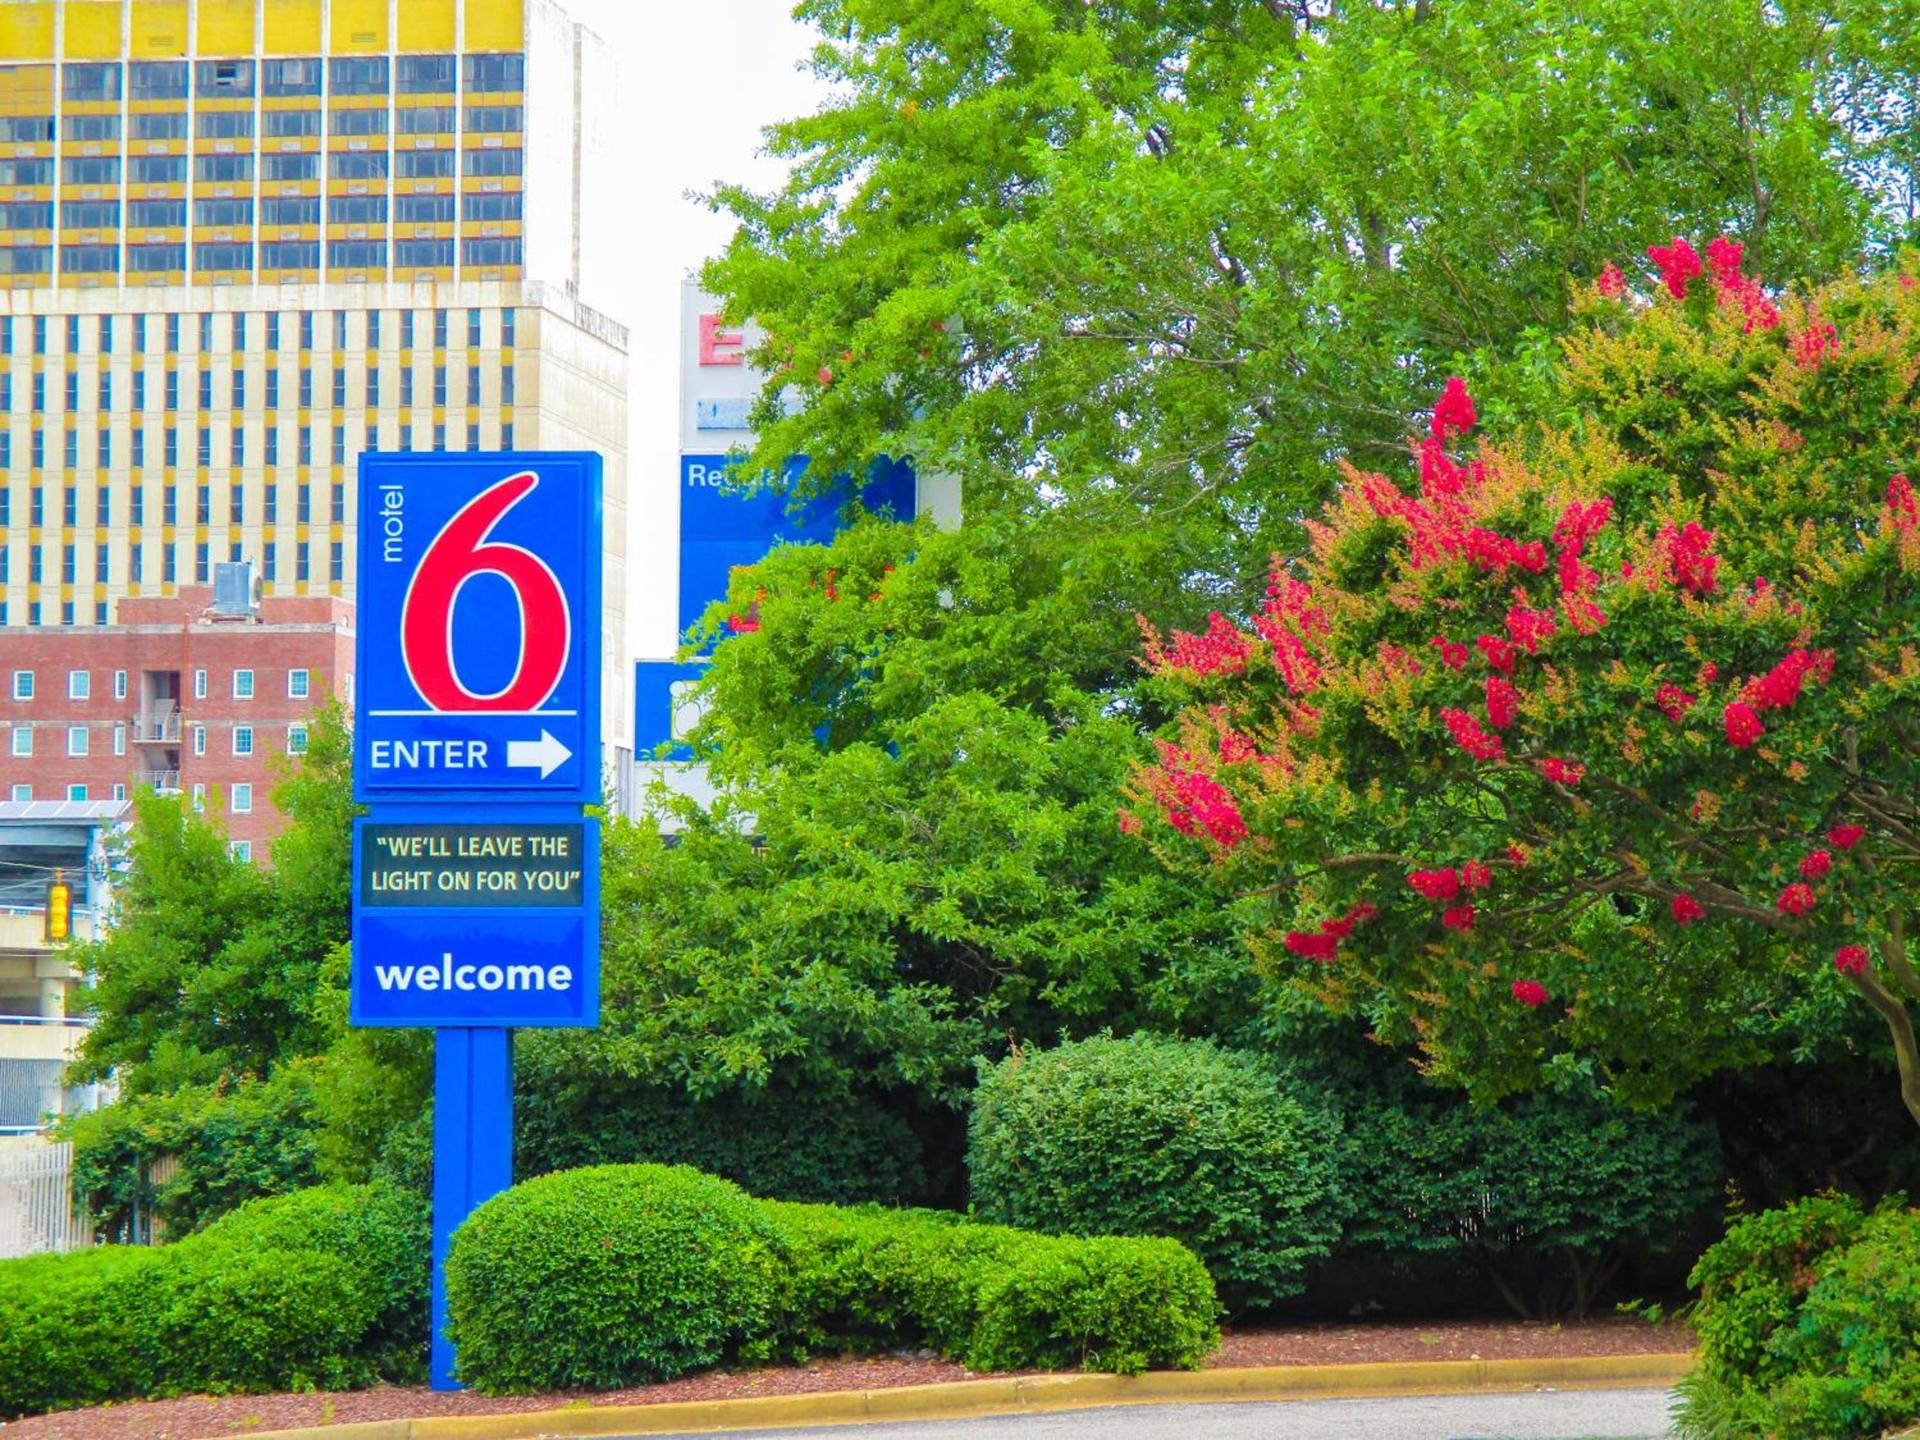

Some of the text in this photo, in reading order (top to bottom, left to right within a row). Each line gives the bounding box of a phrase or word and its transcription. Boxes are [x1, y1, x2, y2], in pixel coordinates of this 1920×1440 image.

[688, 464, 792, 493] Reglar
[379, 485, 404, 562] motel
[401, 470, 572, 713] 6
[371, 740, 488, 769] ENTER
[458, 837, 522, 856] LEAVE
[528, 837, 568, 856] THE
[372, 871, 432, 890] LIGHT
[438, 871, 470, 891] ON
[476, 871, 517, 890] FOR
[375, 952, 573, 991] welcome
